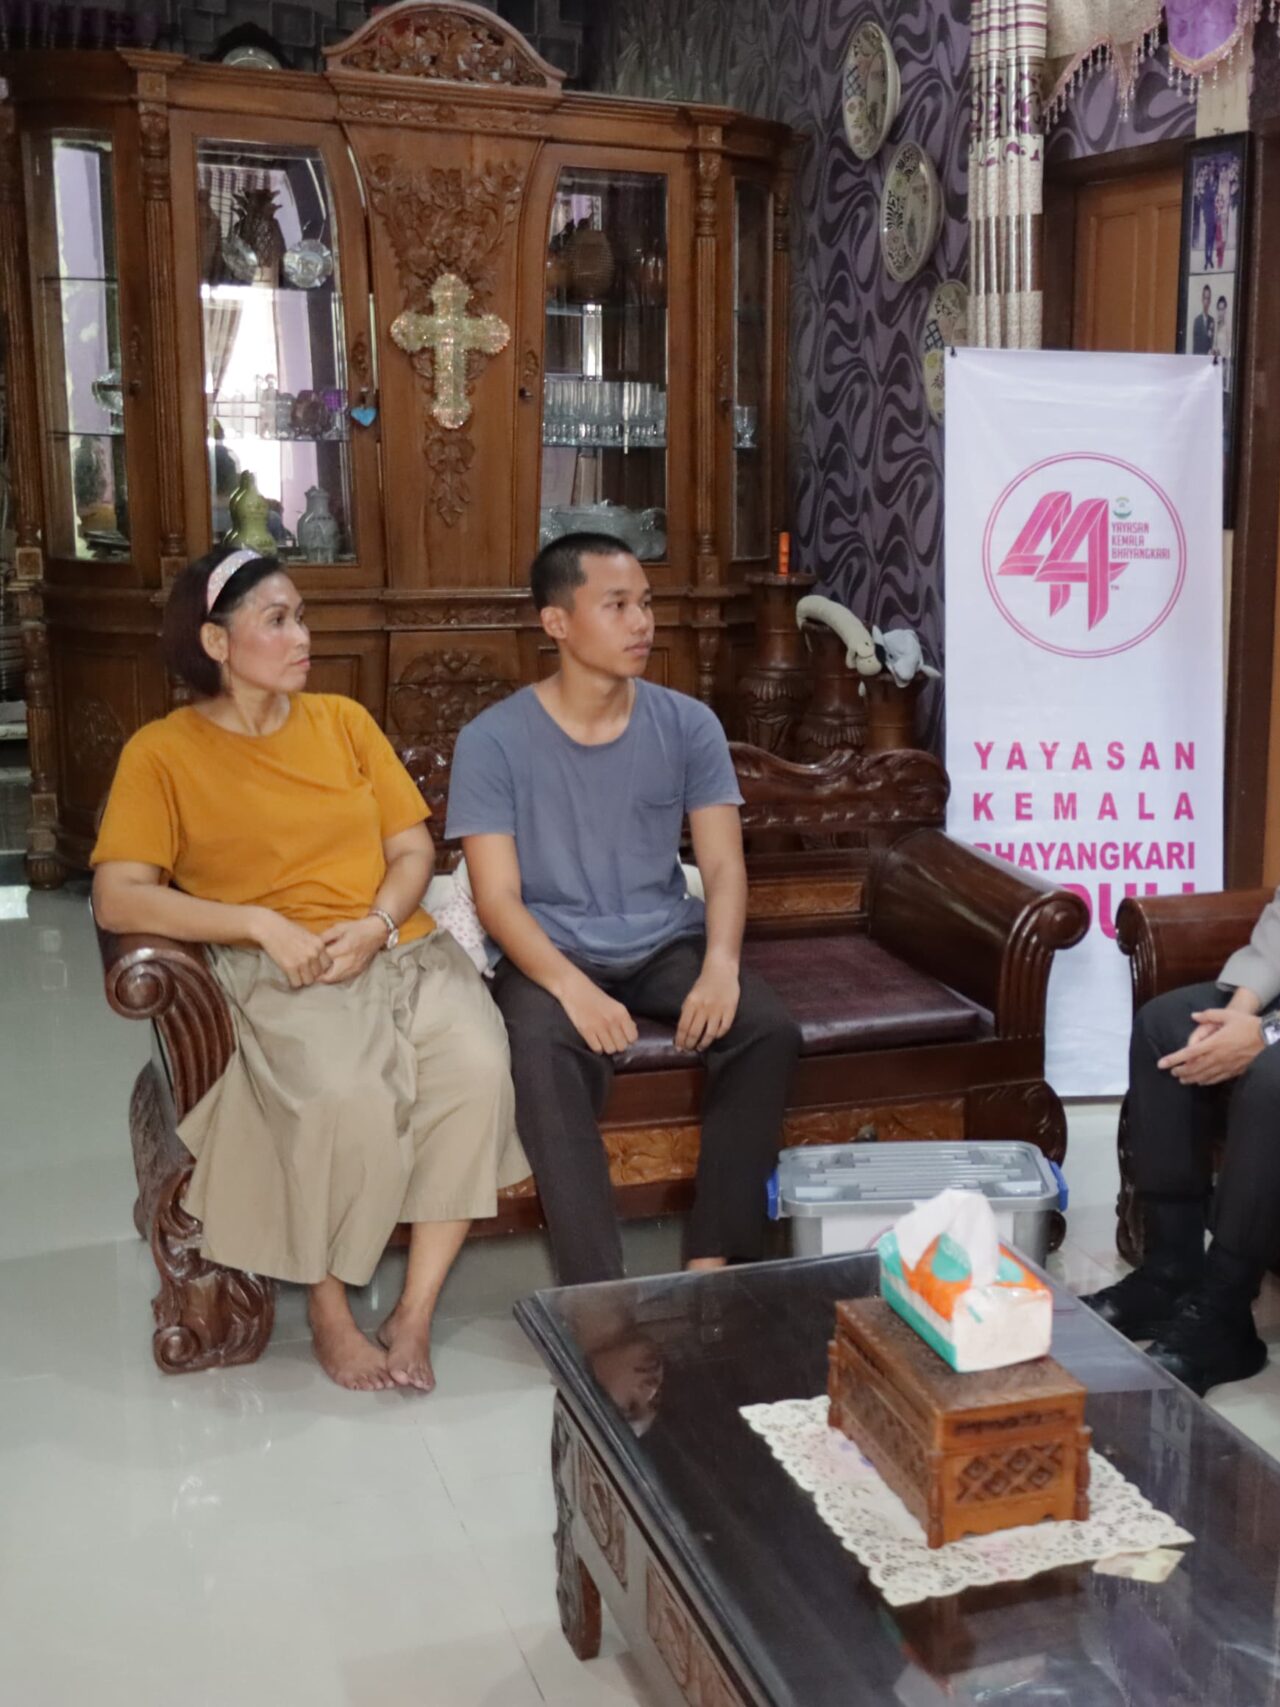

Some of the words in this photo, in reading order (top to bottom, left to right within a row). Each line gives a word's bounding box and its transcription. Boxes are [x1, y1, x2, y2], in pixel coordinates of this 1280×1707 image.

[1111, 522, 1149, 533] YAYASAN
[1111, 535, 1144, 546] KEMALA
[1111, 548, 1170, 559] BHAYANGKARI
[974, 741, 1195, 770] YAYASAN
[972, 792, 1194, 821] KEMALA
